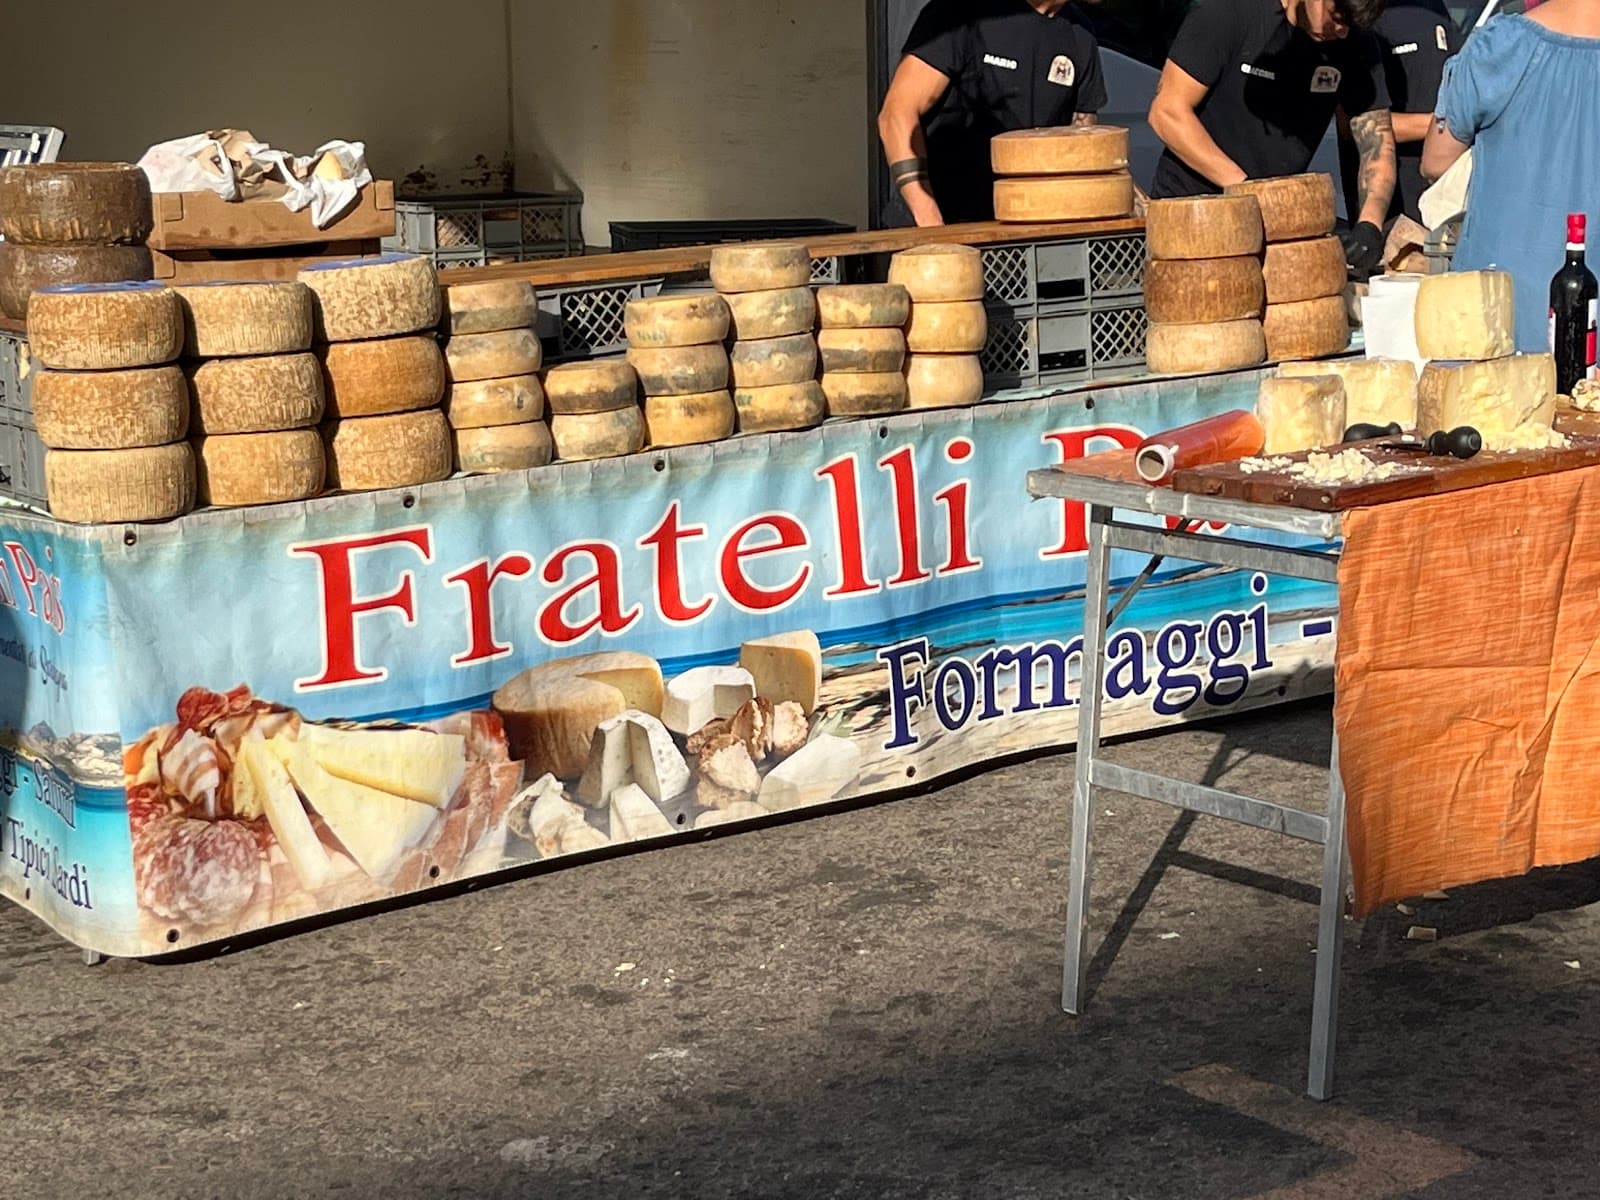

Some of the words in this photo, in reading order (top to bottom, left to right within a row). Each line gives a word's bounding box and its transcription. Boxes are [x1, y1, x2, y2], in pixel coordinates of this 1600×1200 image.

[292, 439, 983, 690] Fratelli
[879, 574, 1273, 750] Formaggi
[7, 816, 52, 879] Tipici
